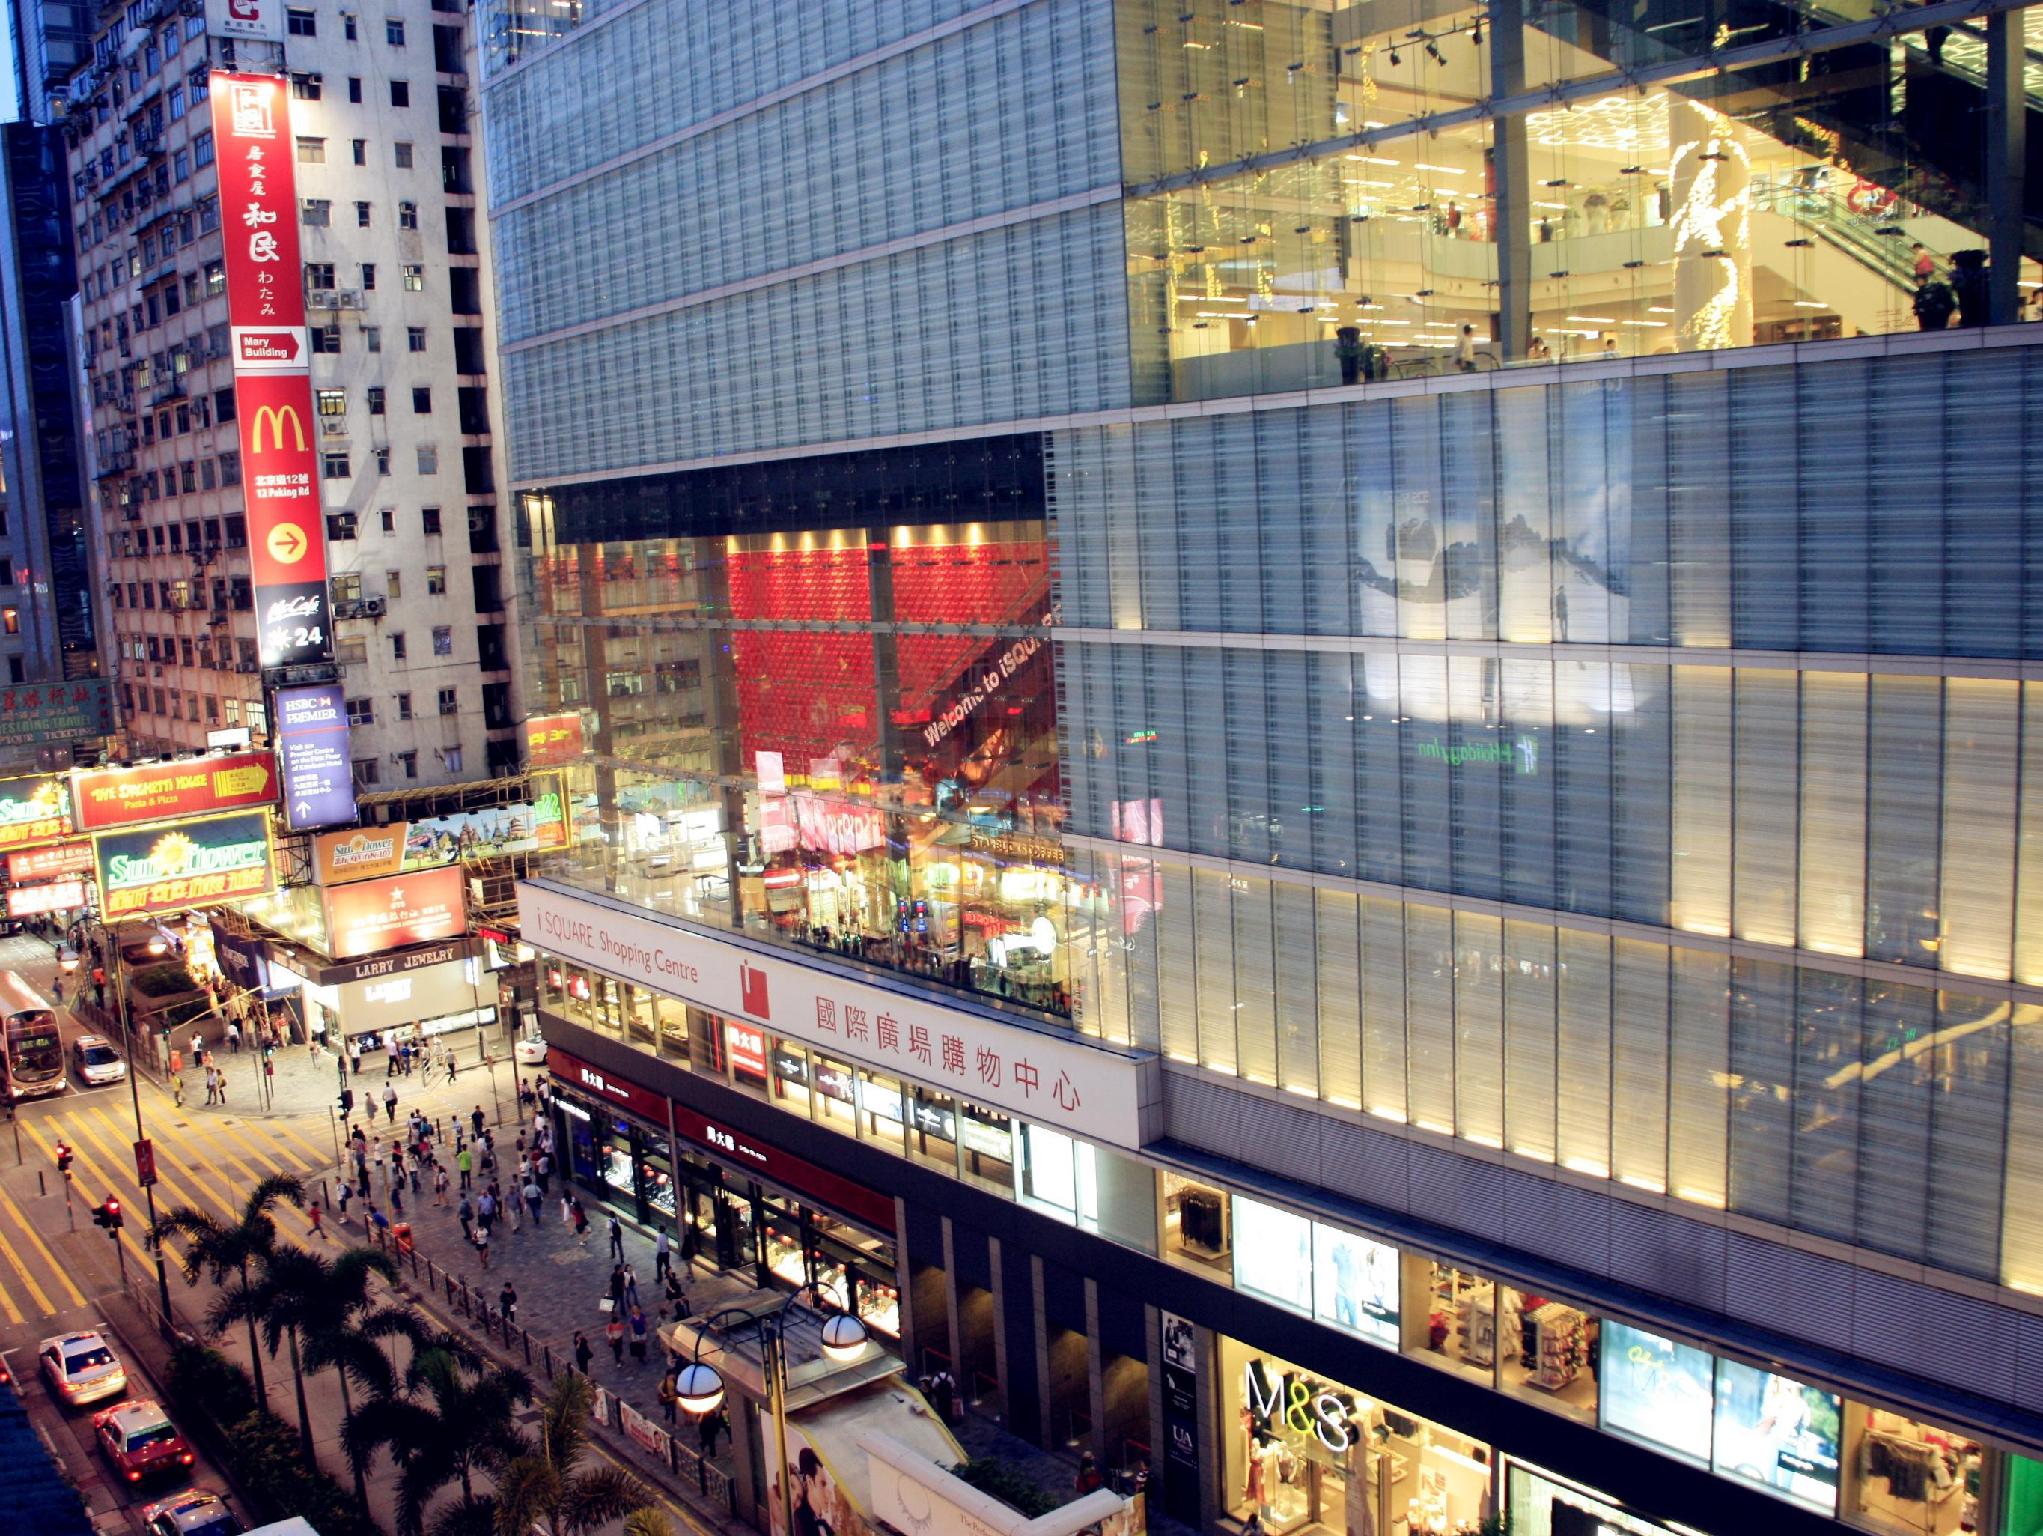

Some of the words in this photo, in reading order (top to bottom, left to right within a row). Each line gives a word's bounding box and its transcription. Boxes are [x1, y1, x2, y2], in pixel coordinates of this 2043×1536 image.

[242, 202, 280, 263] 和民
[257, 270, 276, 316] わたみ
[243, 337, 269, 348] Mary
[245, 347, 288, 359] Building
[269, 486, 298, 499] Peking
[299, 486, 310, 496] Rd
[295, 626, 323, 647] 24
[983, 672, 1000, 693] to
[285, 698, 318, 712] HSBC
[286, 709, 338, 724] PREMIER
[118, 780, 174, 800] SPAGHETTI
[176, 774, 208, 790] HOUSE
[157, 795, 178, 805] Pizza
[545, 911, 595, 950] SQUARE
[600, 930, 652, 974] Shopping
[654, 949, 699, 984] Centre
[355, 960, 394, 978] LARRY
[404, 948, 454, 969] JEWELRY
[816, 996, 1081, 1112] 國際廣場購物中心
[1246, 1360, 1349, 1452] M&S
[1172, 1424, 1193, 1449] UA
